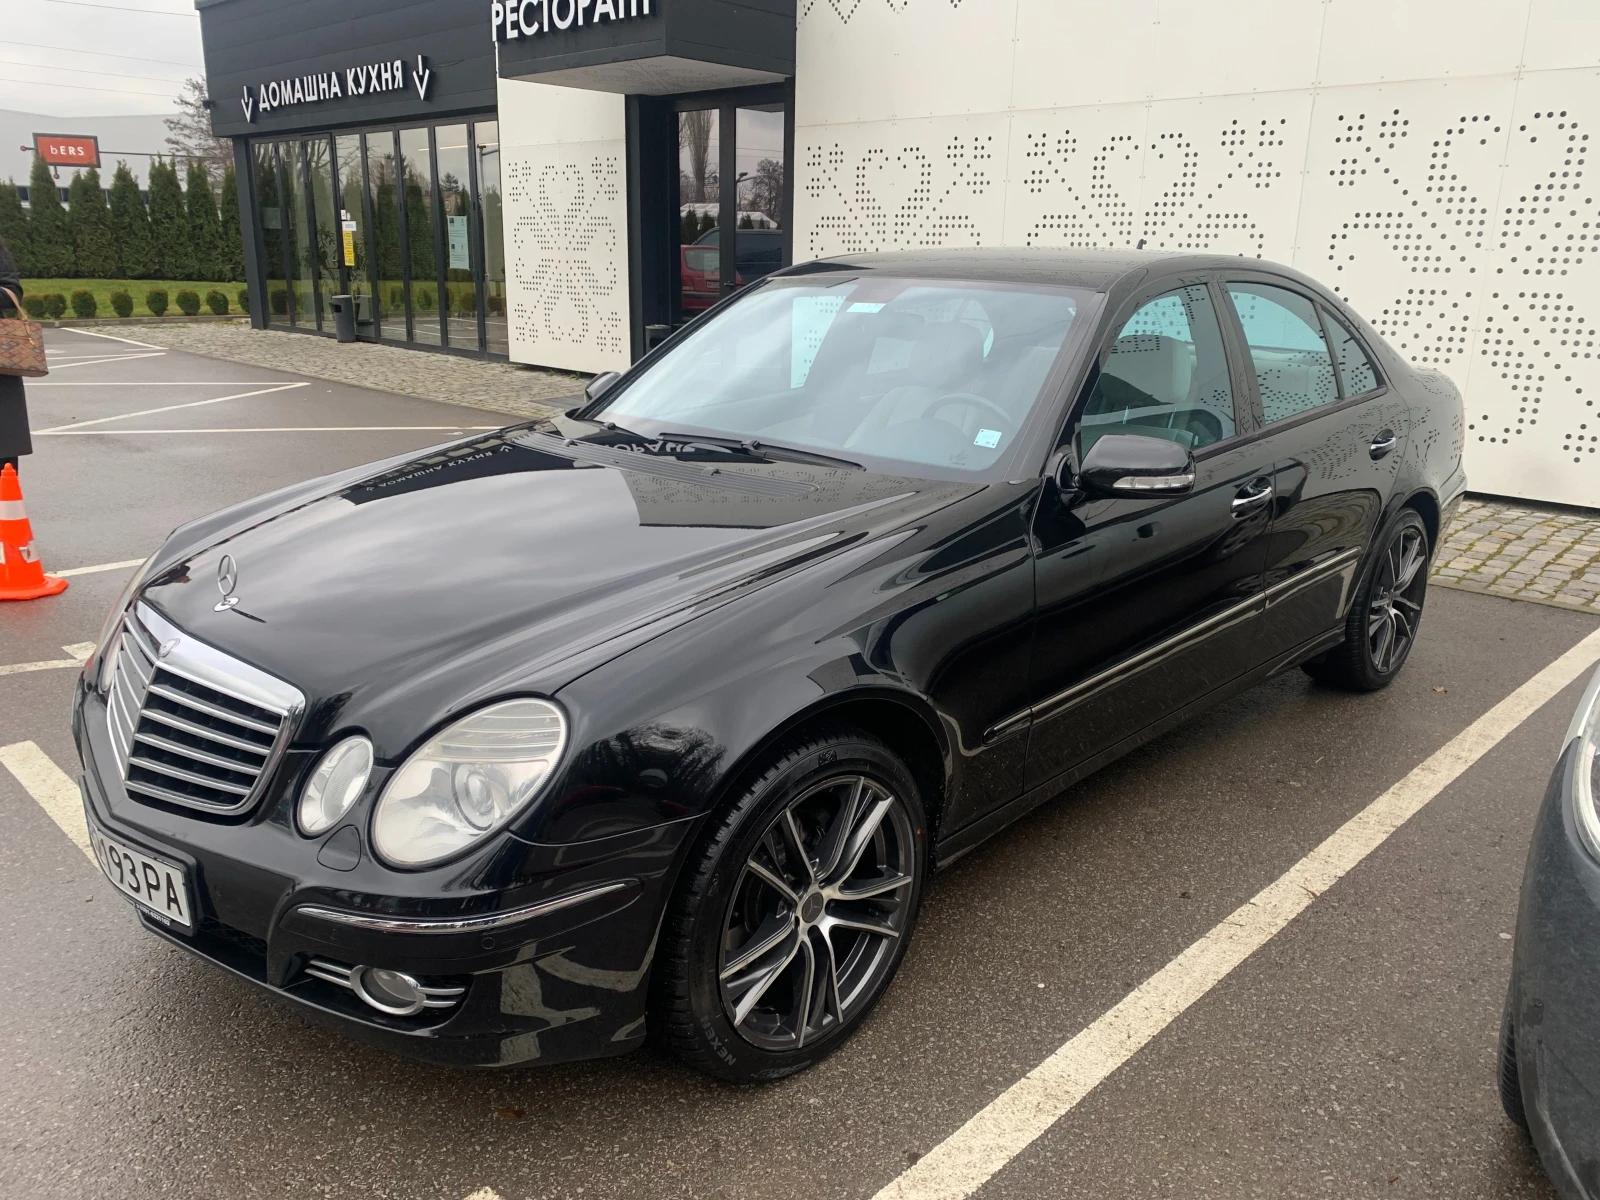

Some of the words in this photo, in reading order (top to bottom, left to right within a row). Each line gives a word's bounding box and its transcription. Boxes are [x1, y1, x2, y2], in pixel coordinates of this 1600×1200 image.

[258, 71, 342, 113] ДОМАШНА
[346, 59, 404, 96] КУХНЯ
[49, 144, 85, 156] bERS
[700, 1014, 737, 1066] NEXEN
